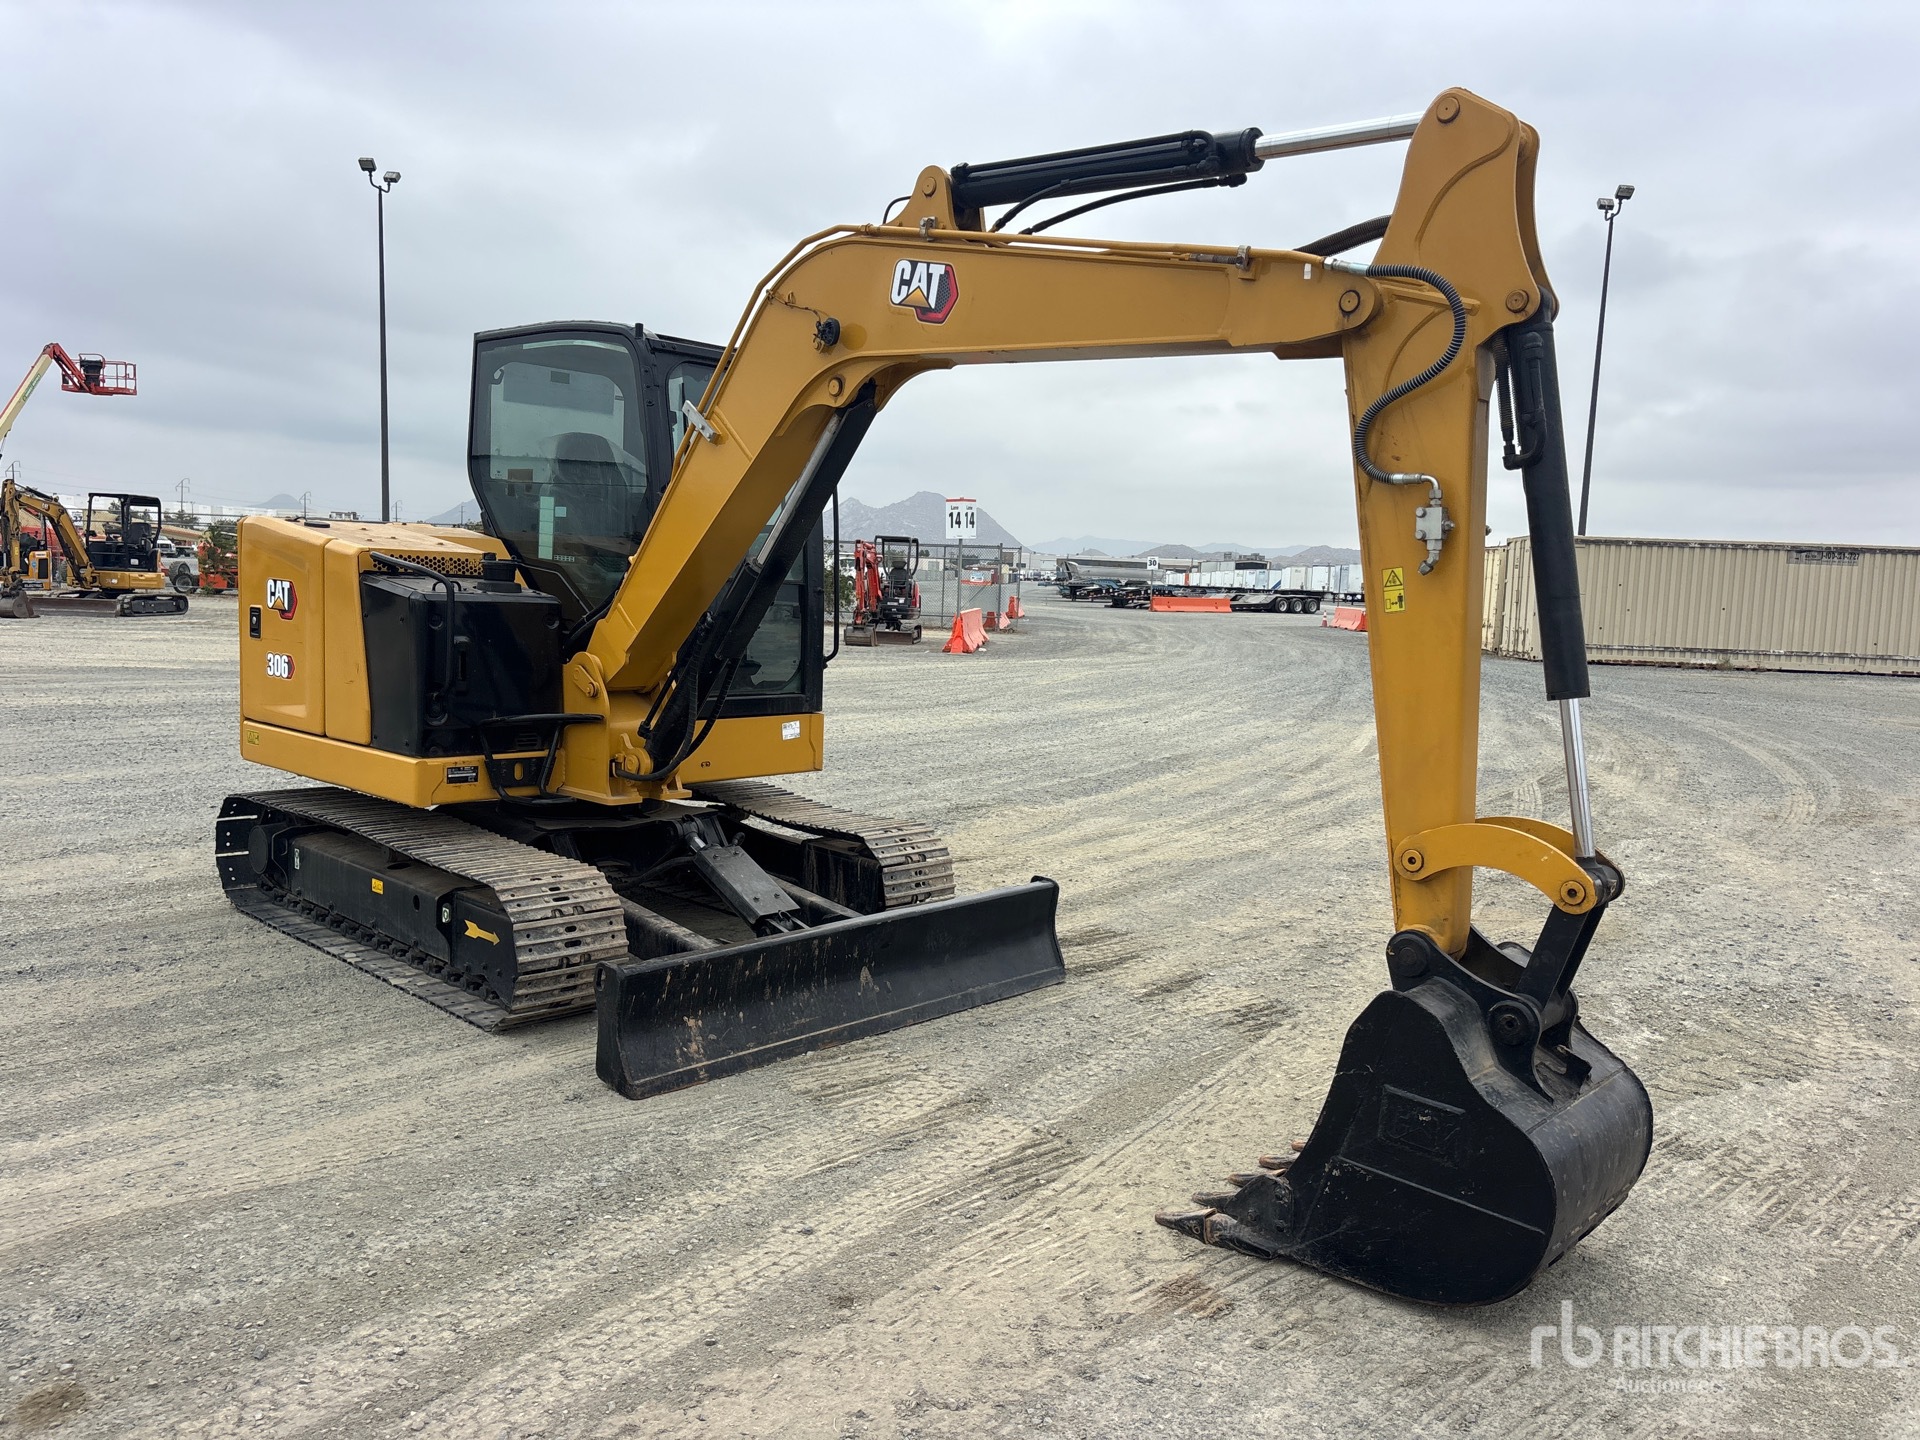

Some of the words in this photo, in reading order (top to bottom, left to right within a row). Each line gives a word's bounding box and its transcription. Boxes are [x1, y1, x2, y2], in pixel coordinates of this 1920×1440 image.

[890, 259, 946, 309] CAT
[948, 511, 962, 529] 14
[964, 511, 975, 529] 14
[1148, 559, 1157, 567] 30
[267, 579, 290, 611] CAT
[267, 653, 289, 679] 306
